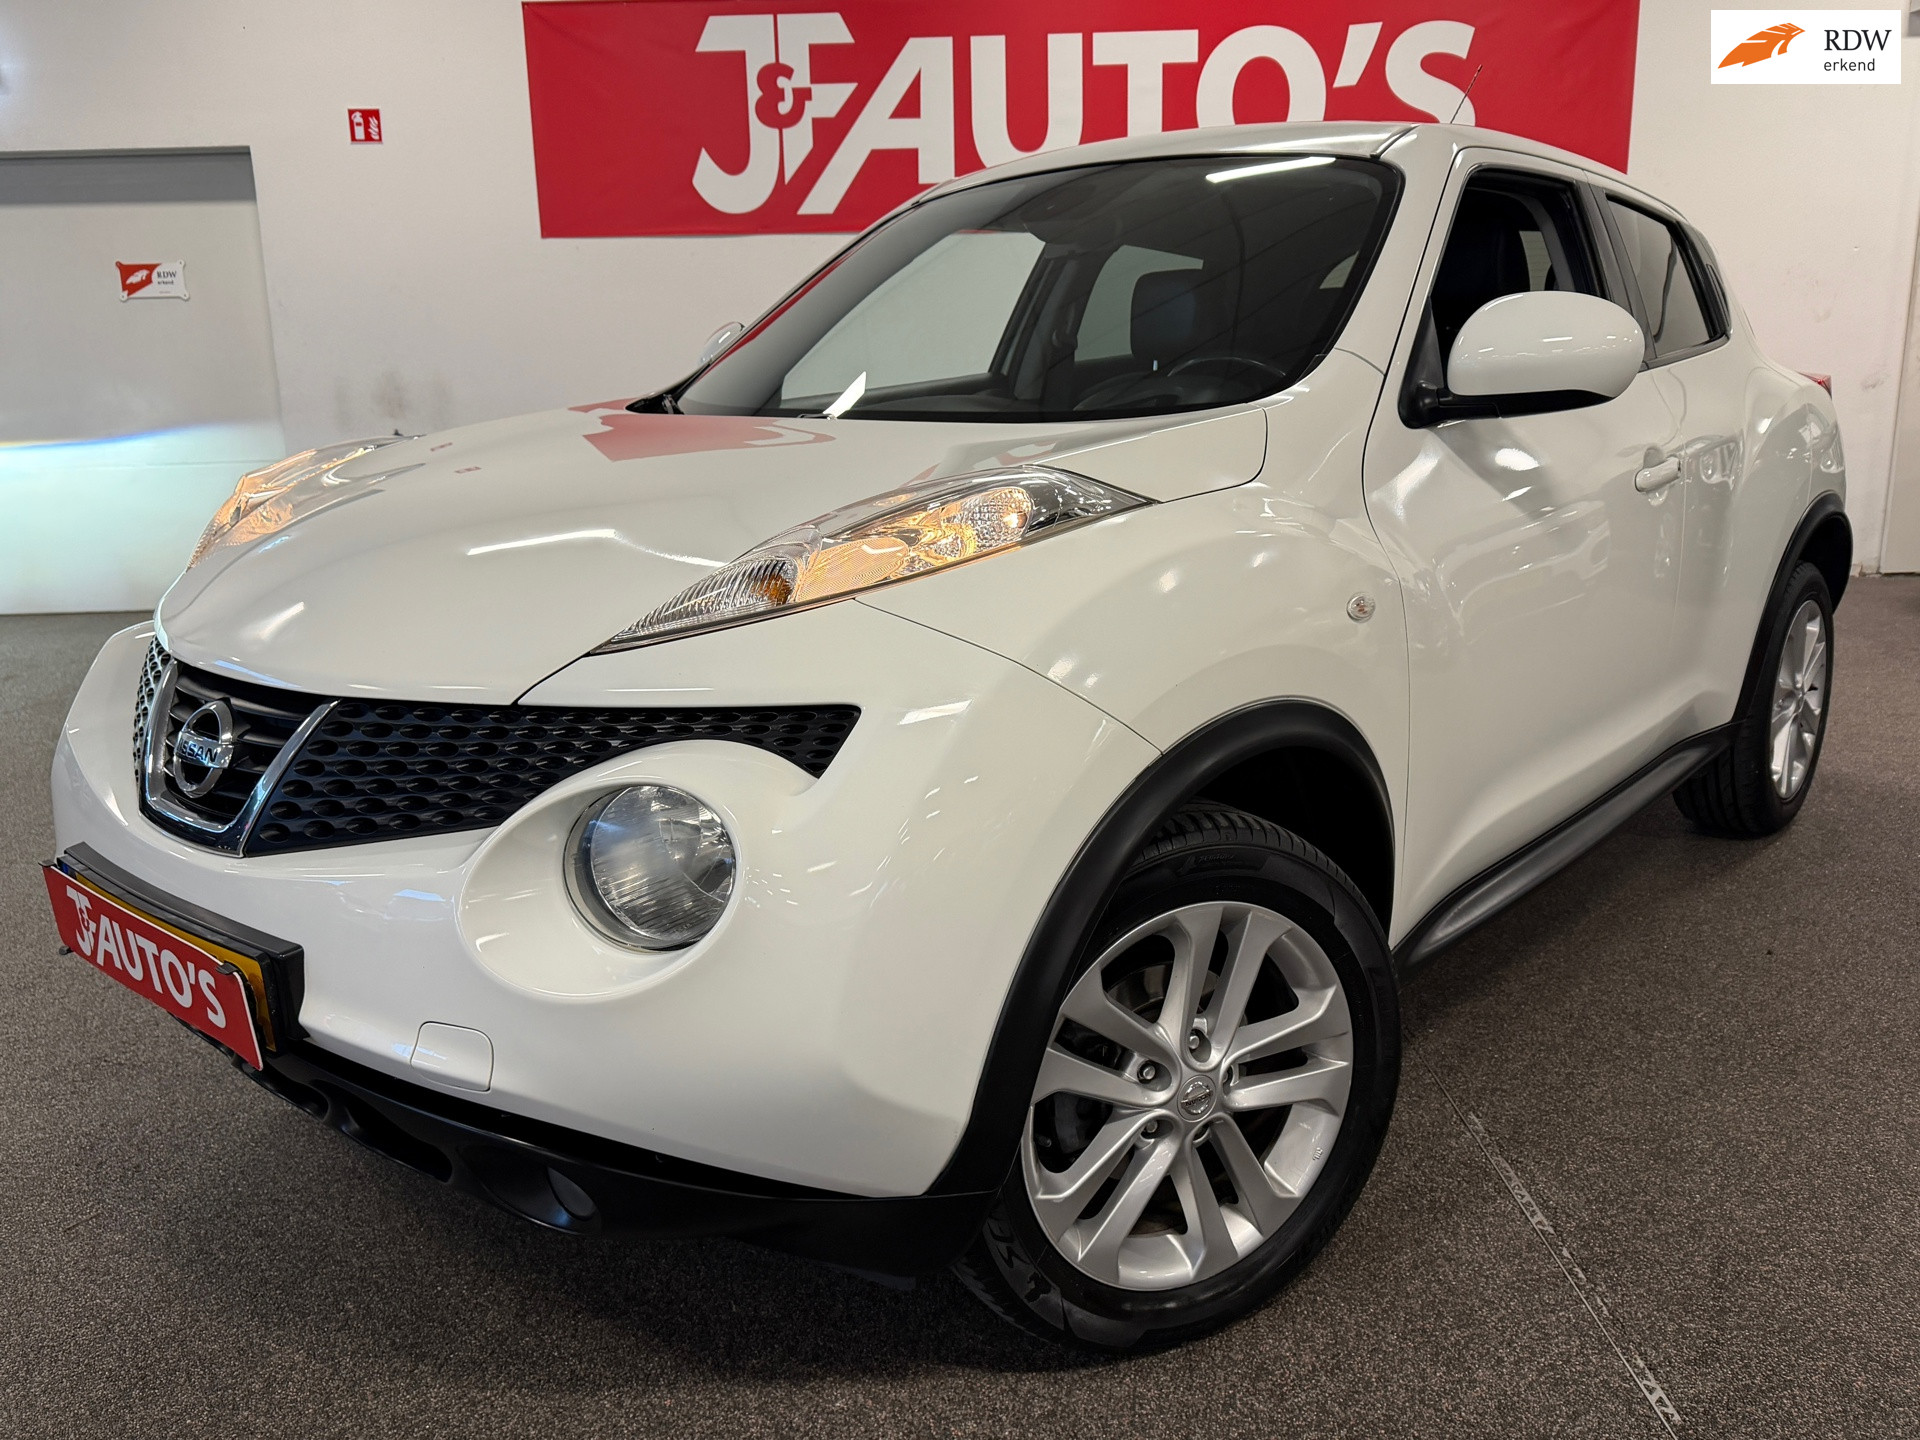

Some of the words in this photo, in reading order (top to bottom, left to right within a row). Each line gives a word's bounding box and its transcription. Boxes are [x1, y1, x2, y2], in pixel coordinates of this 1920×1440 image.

[797, 20, 1476, 214] AUTO'S
[157, 271, 176, 279] RDW
[178, 740, 218, 763] SSAN
[96, 914, 226, 1028] AUTO'S
